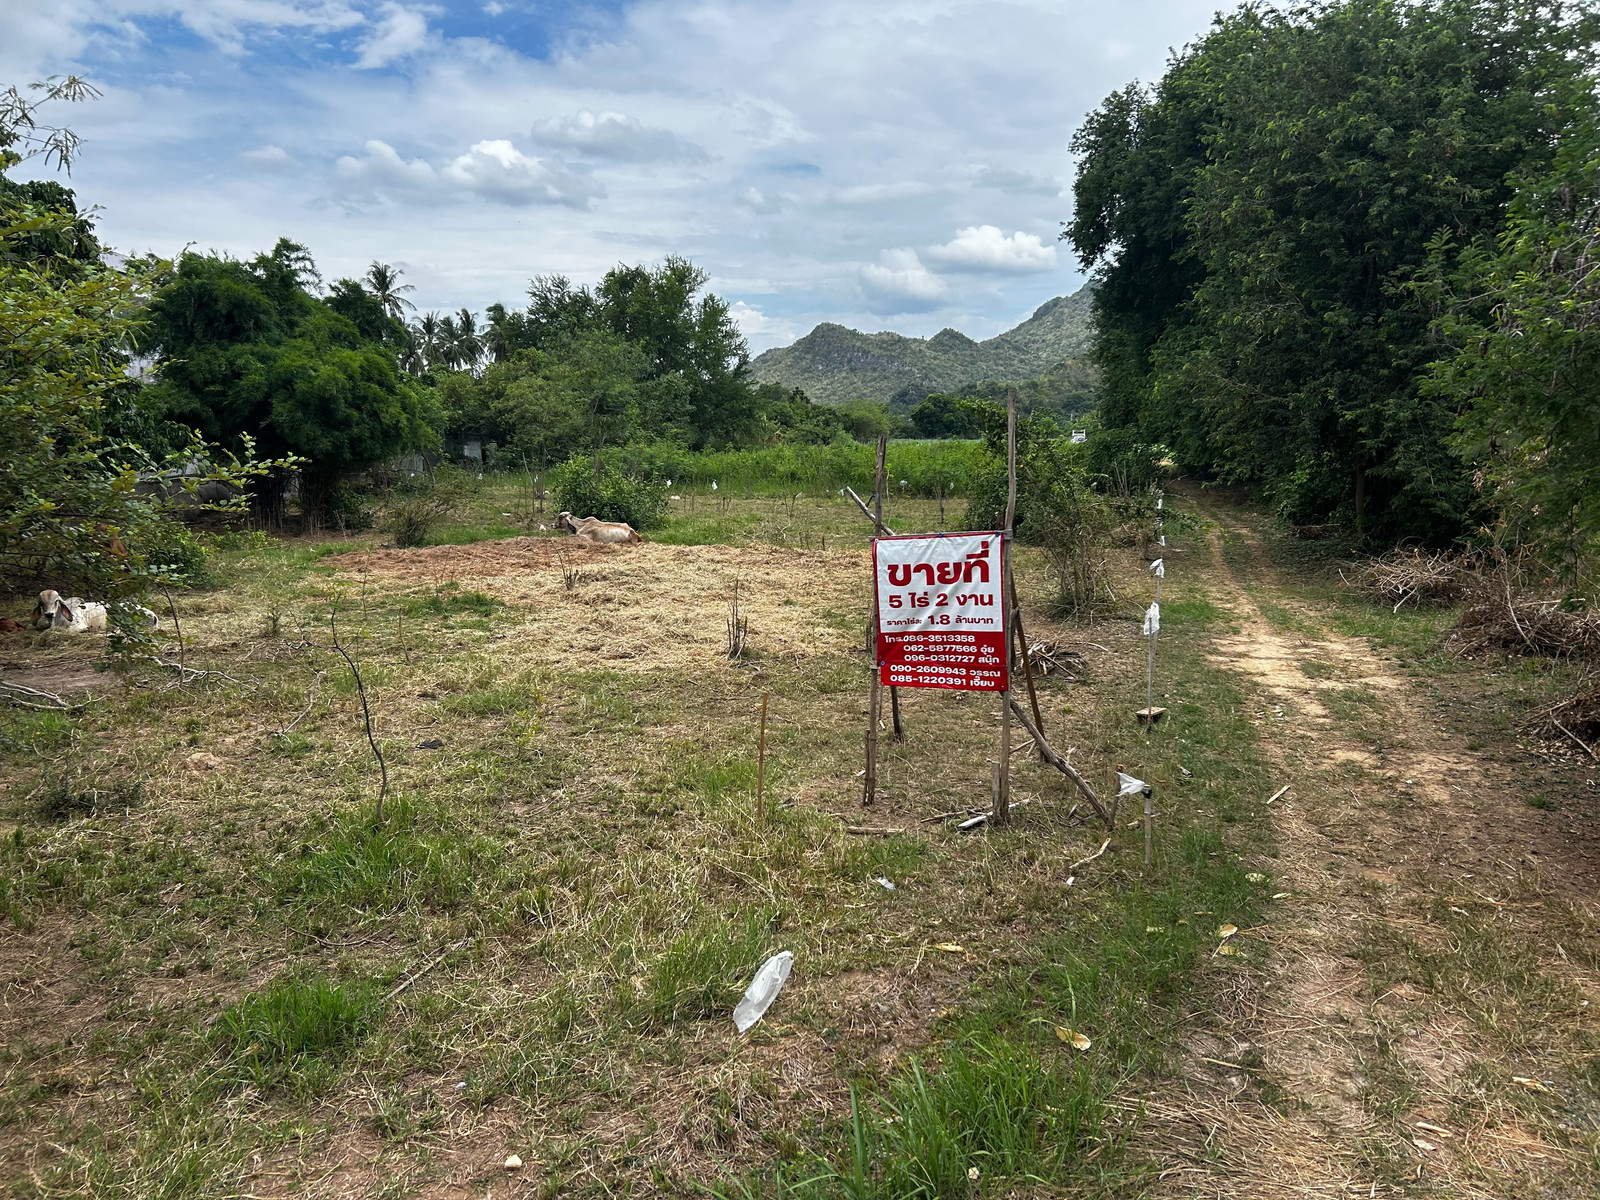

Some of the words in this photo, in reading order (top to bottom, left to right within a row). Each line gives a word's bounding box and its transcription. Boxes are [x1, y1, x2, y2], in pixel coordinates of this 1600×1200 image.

[887, 541, 990, 586] ขายที่
[888, 594, 902, 608] 5
[908, 592, 930, 608] ไร่
[936, 593, 948, 606] 2
[956, 594, 994, 606] งาน
[928, 614, 950, 625] 1.8
[955, 616, 994, 624] ล้านบาท
[904, 654, 974, 663] 096-0312727
[890, 664, 966, 676] 090-2609943
[890, 675, 966, 686] 085-1220391
